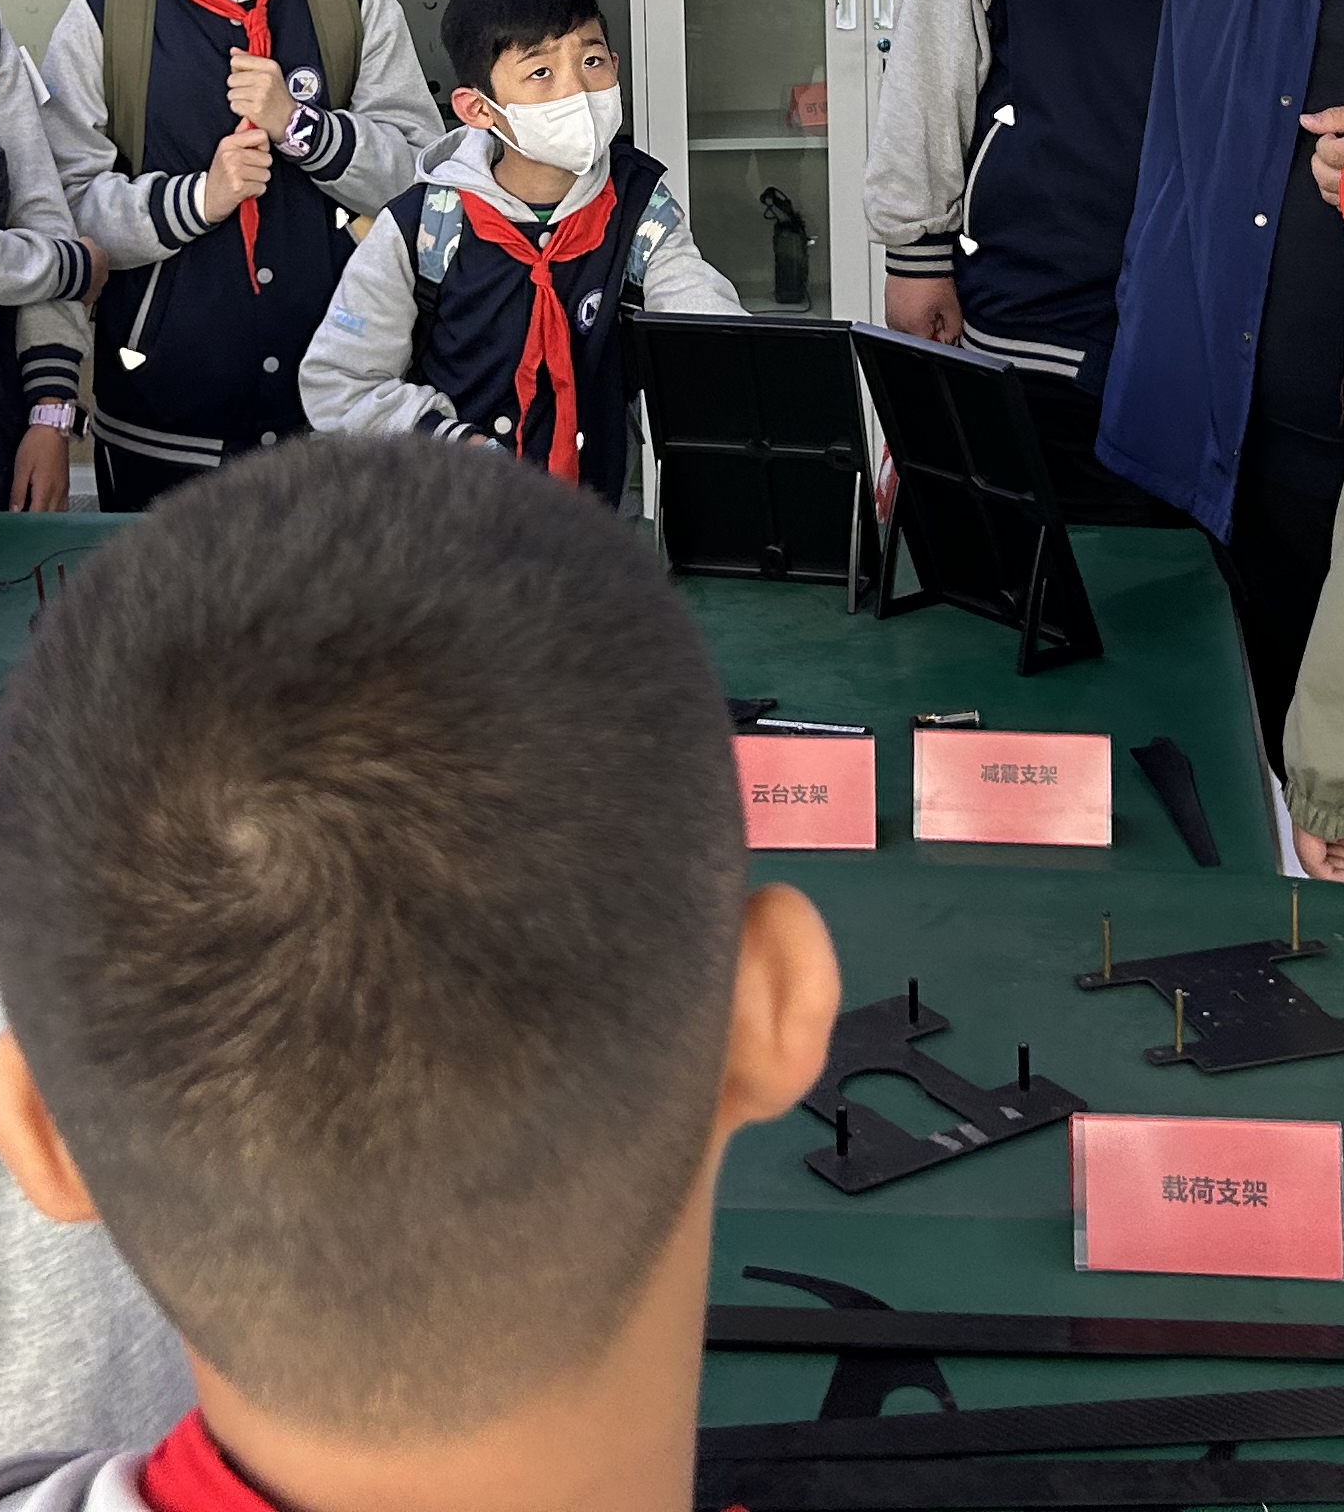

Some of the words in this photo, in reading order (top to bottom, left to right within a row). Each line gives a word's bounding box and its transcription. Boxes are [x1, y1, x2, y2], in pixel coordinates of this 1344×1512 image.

[980, 763, 1058, 785] 减震支架
[751, 783, 829, 804] 云台支架
[1161, 1174, 1269, 1208] 载荷支架
